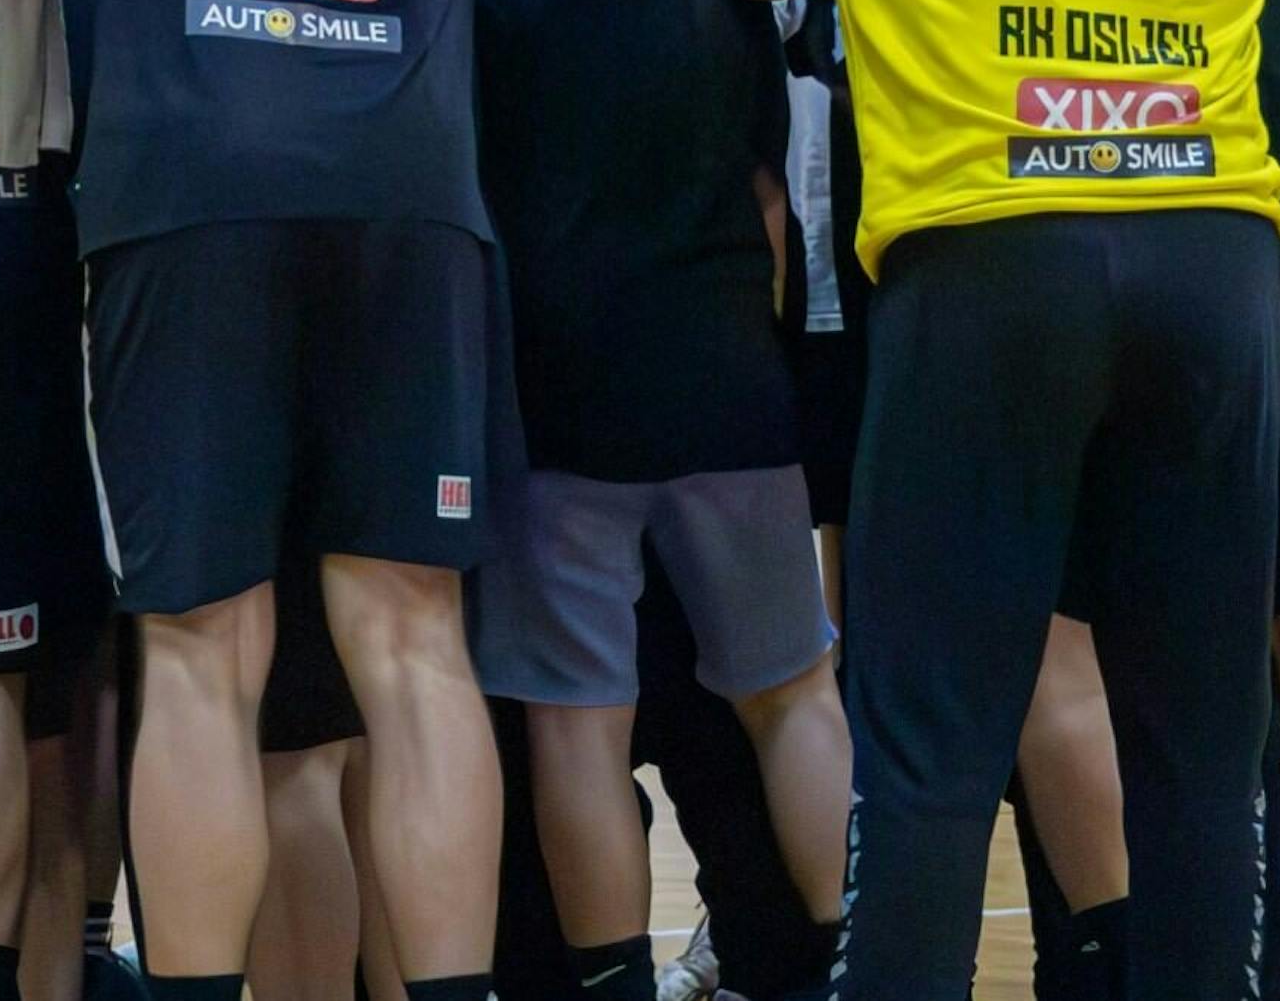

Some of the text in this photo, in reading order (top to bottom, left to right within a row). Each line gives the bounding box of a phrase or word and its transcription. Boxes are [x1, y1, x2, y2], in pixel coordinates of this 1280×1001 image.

[301, 14, 388, 43] SMILE
[999, 6, 1209, 68] RK OSIJEK
[1032, 87, 1188, 131] XIXO
[1127, 142, 1206, 170] SMILE
